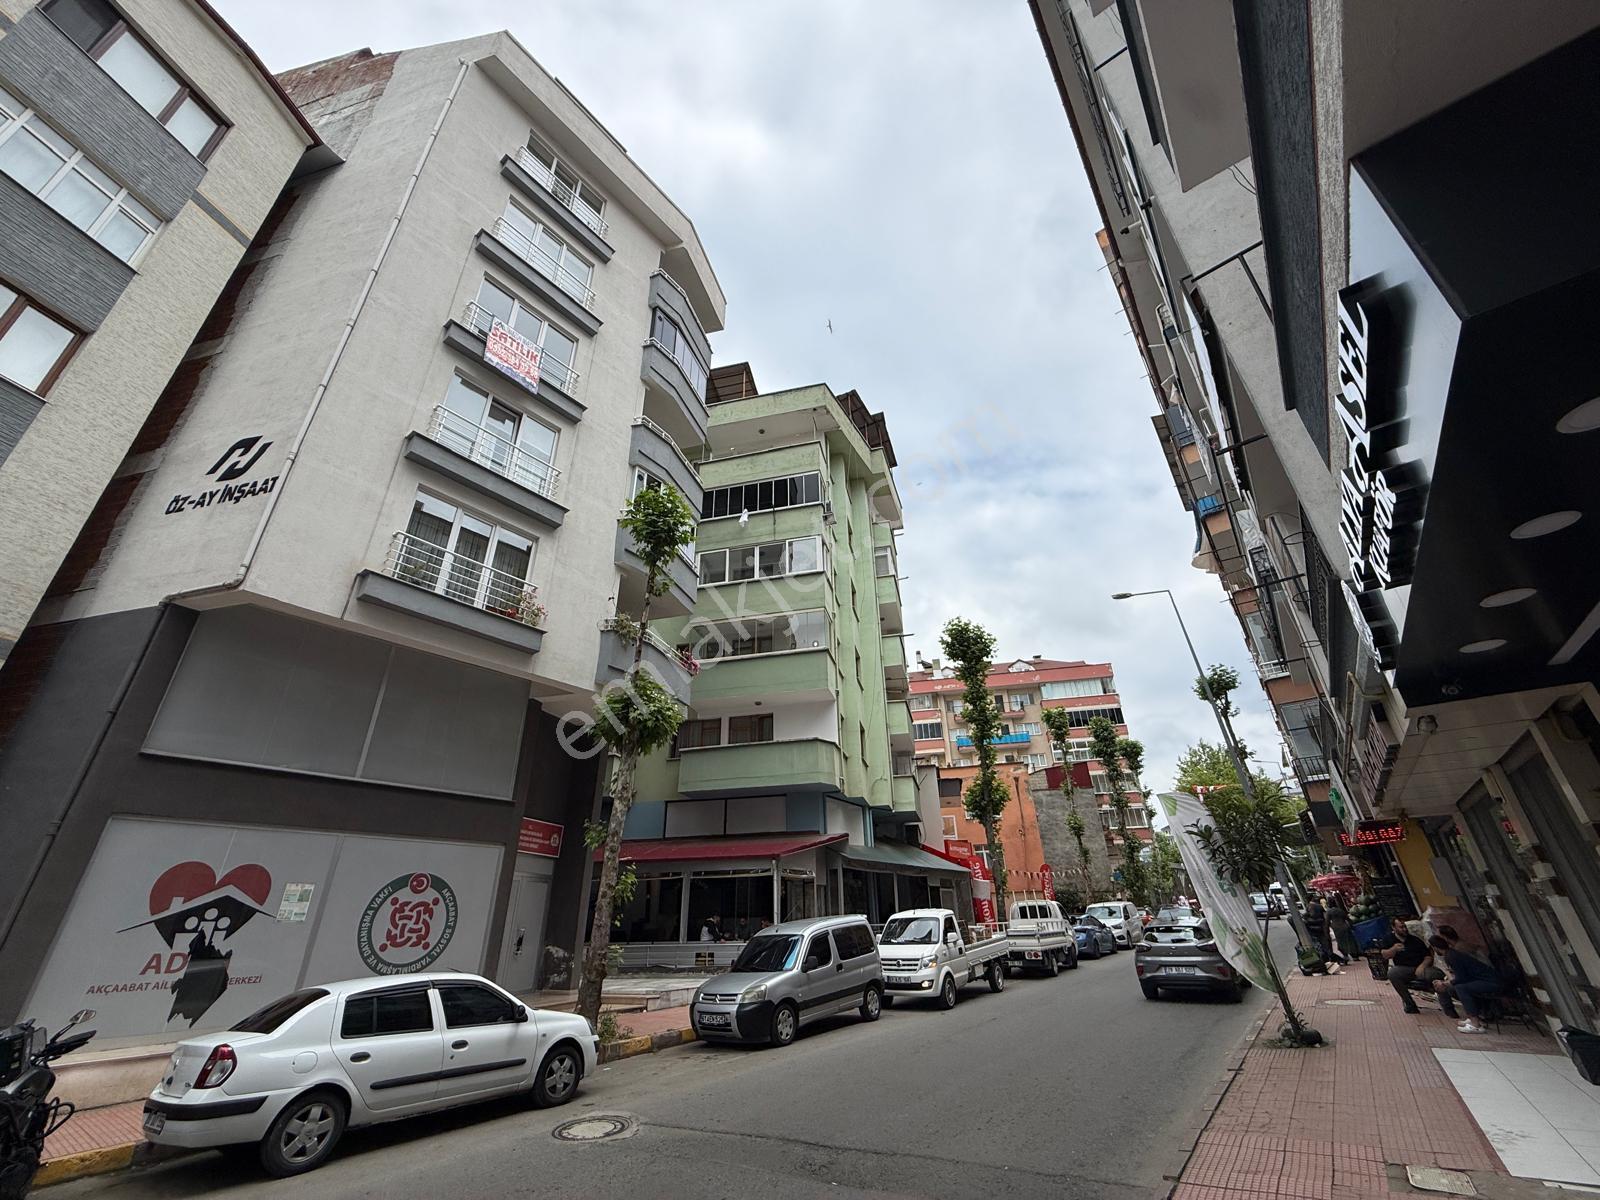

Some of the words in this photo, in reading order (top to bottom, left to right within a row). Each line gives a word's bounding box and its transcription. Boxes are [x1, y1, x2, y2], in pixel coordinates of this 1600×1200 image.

[491, 326, 540, 364] SATILIK
[1335, 290, 1371, 492] ASEL
[165, 489, 221, 515] ÖZ-AY
[217, 476, 280, 504] İNŞAAT
[1369, 470, 1397, 591] KUAFÖR
[367, 955, 377, 968] VE
[431, 928, 452, 959] SOSYAL
[86, 982, 151, 996] AKÇAABAT
[151, 982, 175, 991] AİL
[228, 974, 263, 986] ERKEZİ
